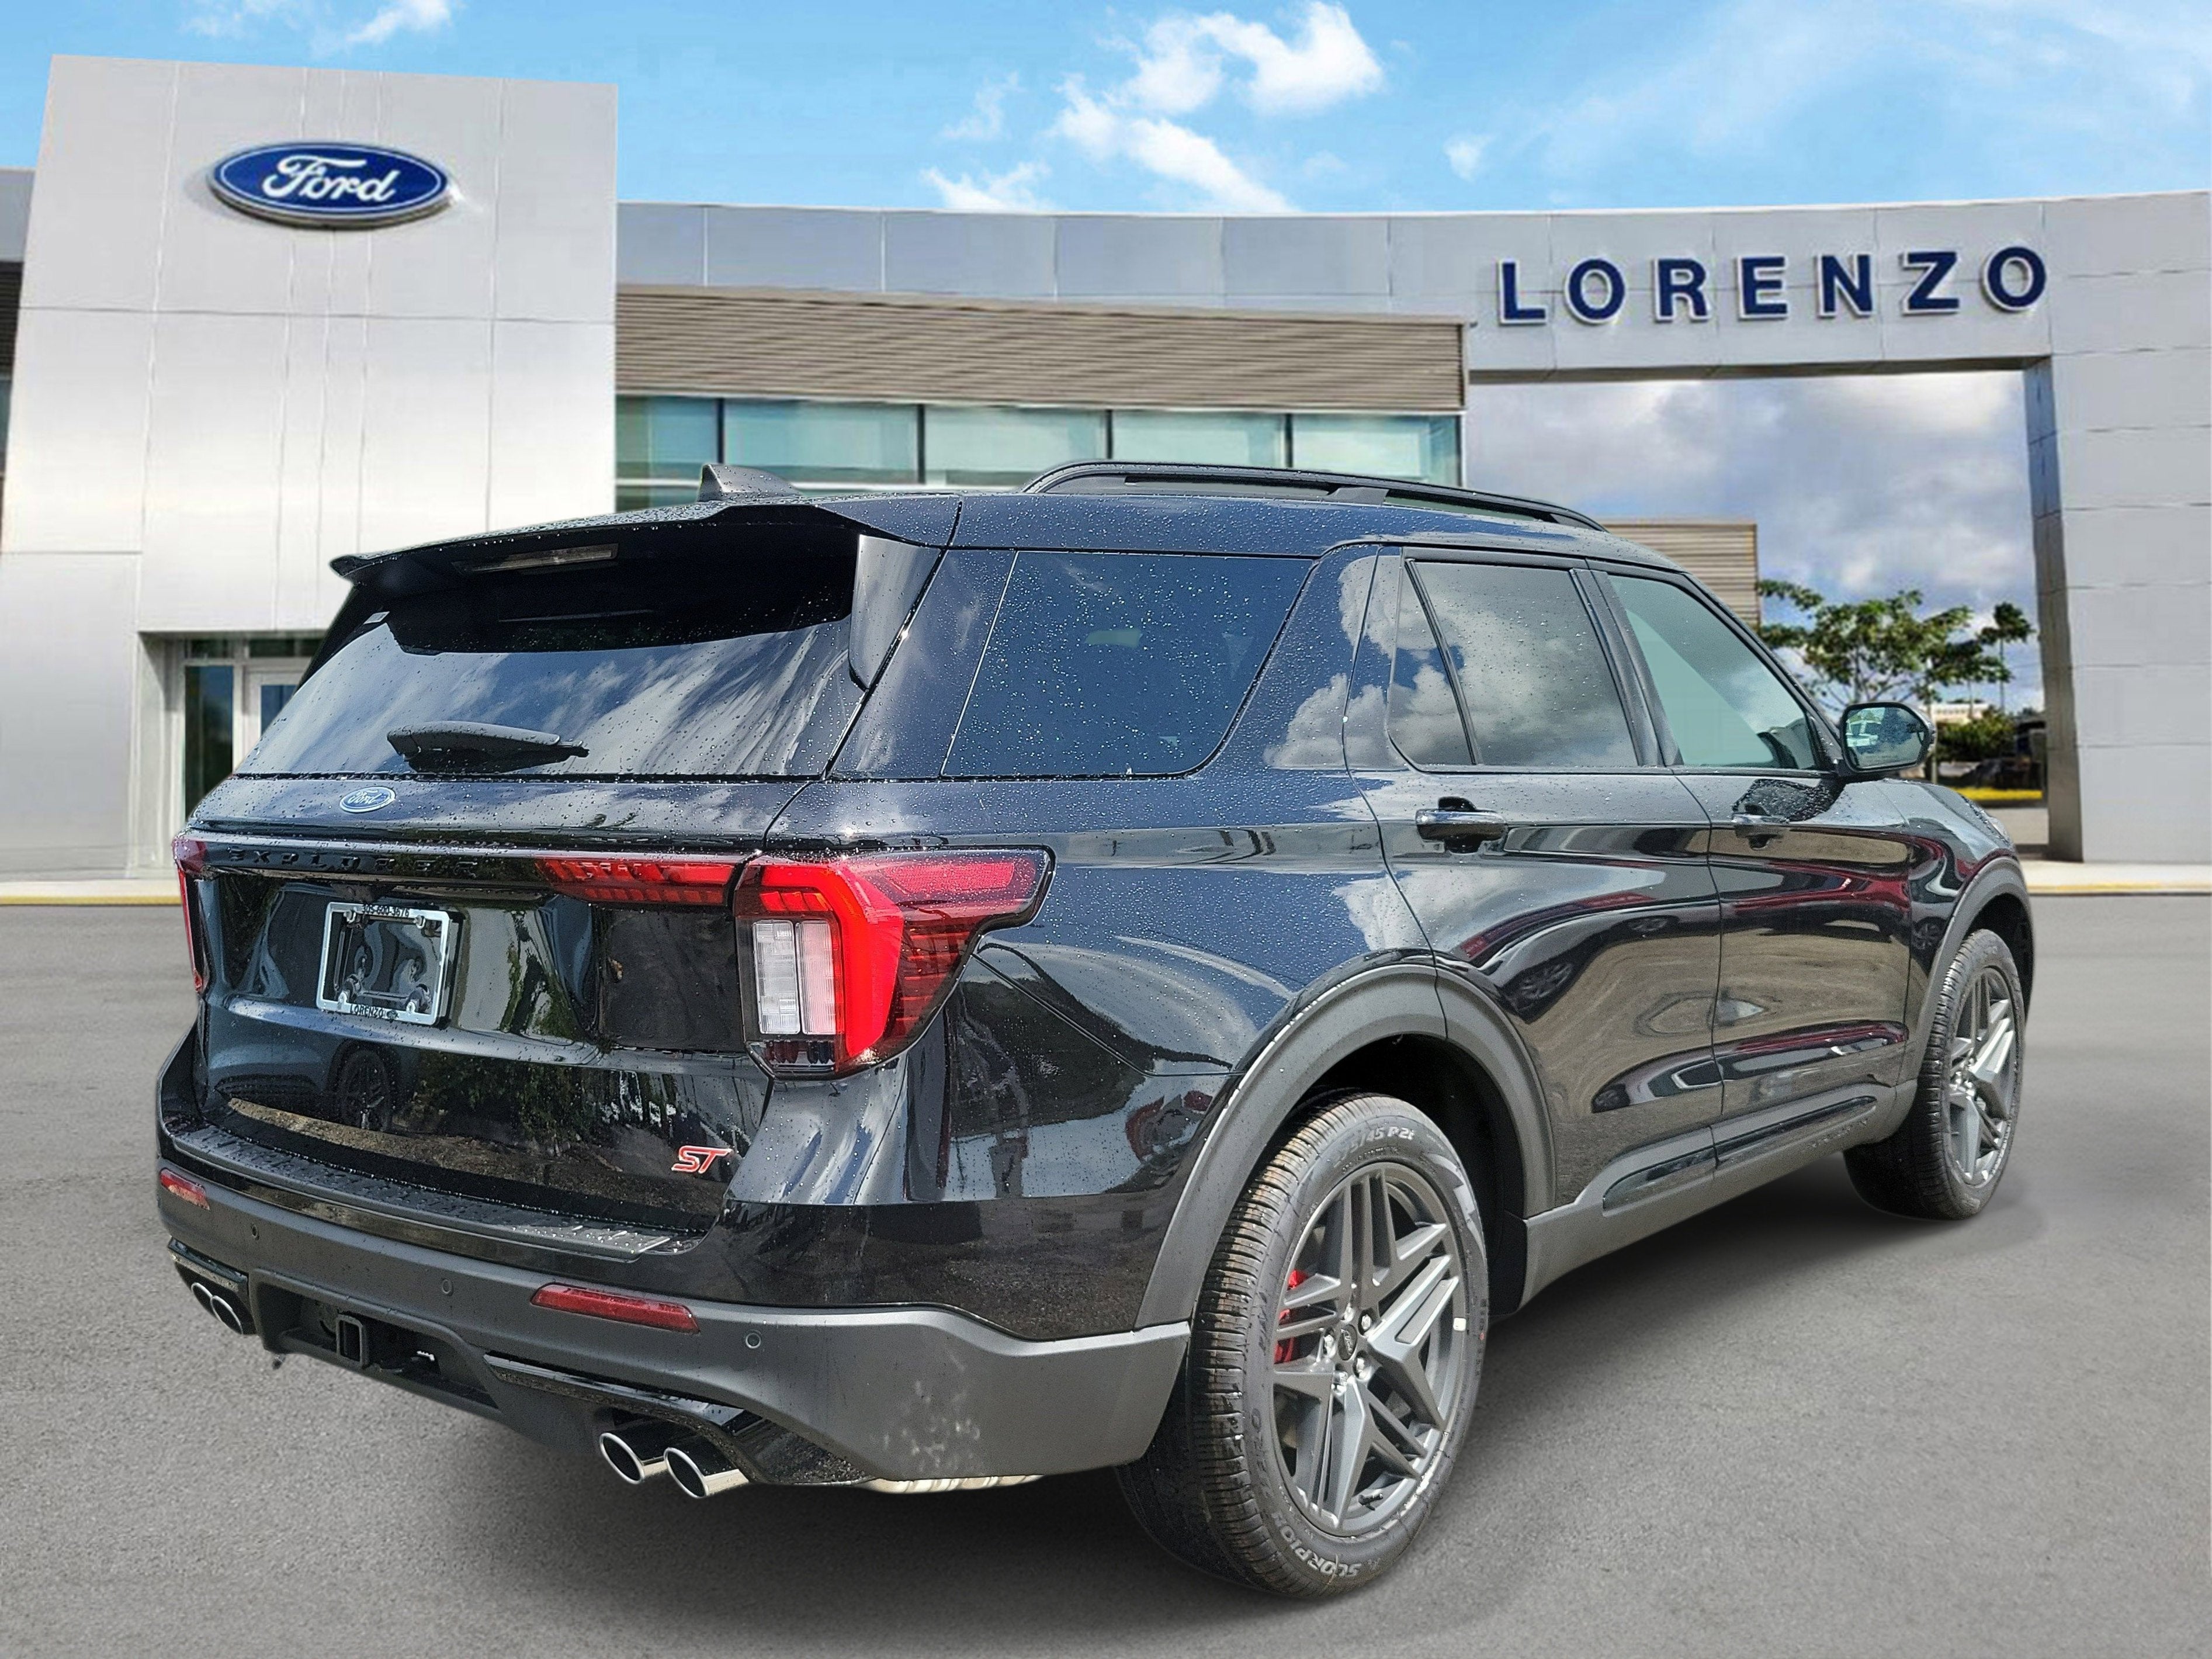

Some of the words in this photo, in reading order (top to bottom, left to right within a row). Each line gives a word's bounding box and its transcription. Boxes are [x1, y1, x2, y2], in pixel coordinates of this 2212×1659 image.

[262, 154, 401, 202] Ford
[1498, 245, 2047, 325] LORENZO
[347, 789, 382, 805] Ford
[226, 846, 478, 877] EXPLORER
[351, 1004, 384, 1020] LORENZO
[671, 1145, 732, 1174] ST
